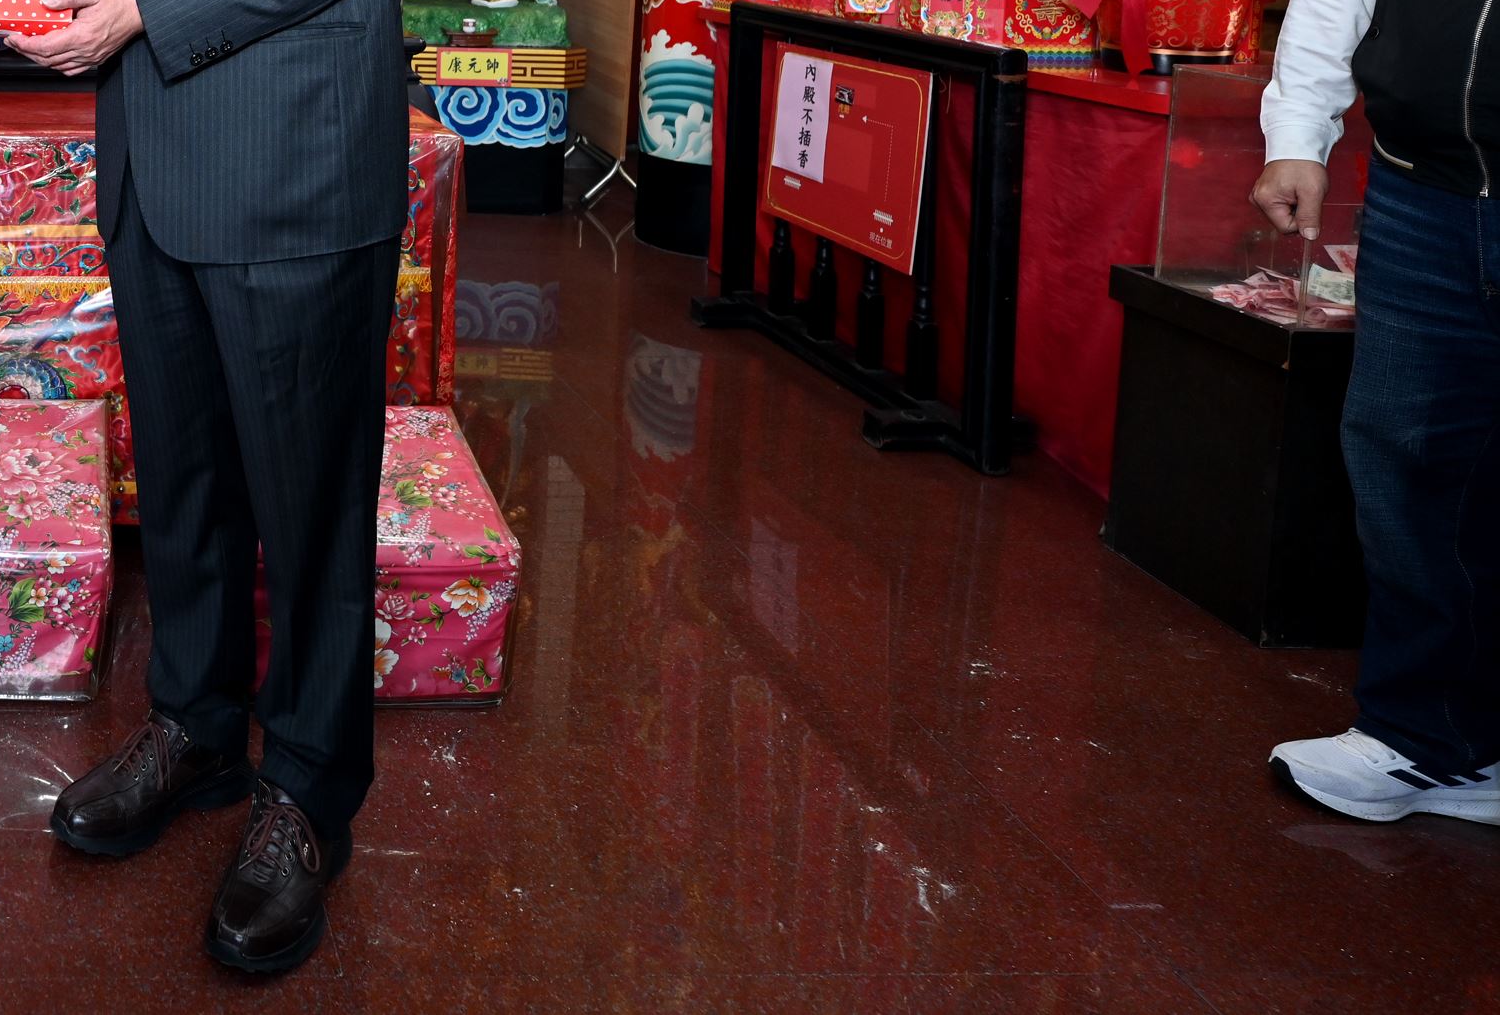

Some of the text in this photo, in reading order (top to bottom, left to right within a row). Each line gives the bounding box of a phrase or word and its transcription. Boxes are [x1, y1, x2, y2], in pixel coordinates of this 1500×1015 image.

[447, 57, 500, 74] 康元帥
[797, 63, 817, 169] 內殿不插香
